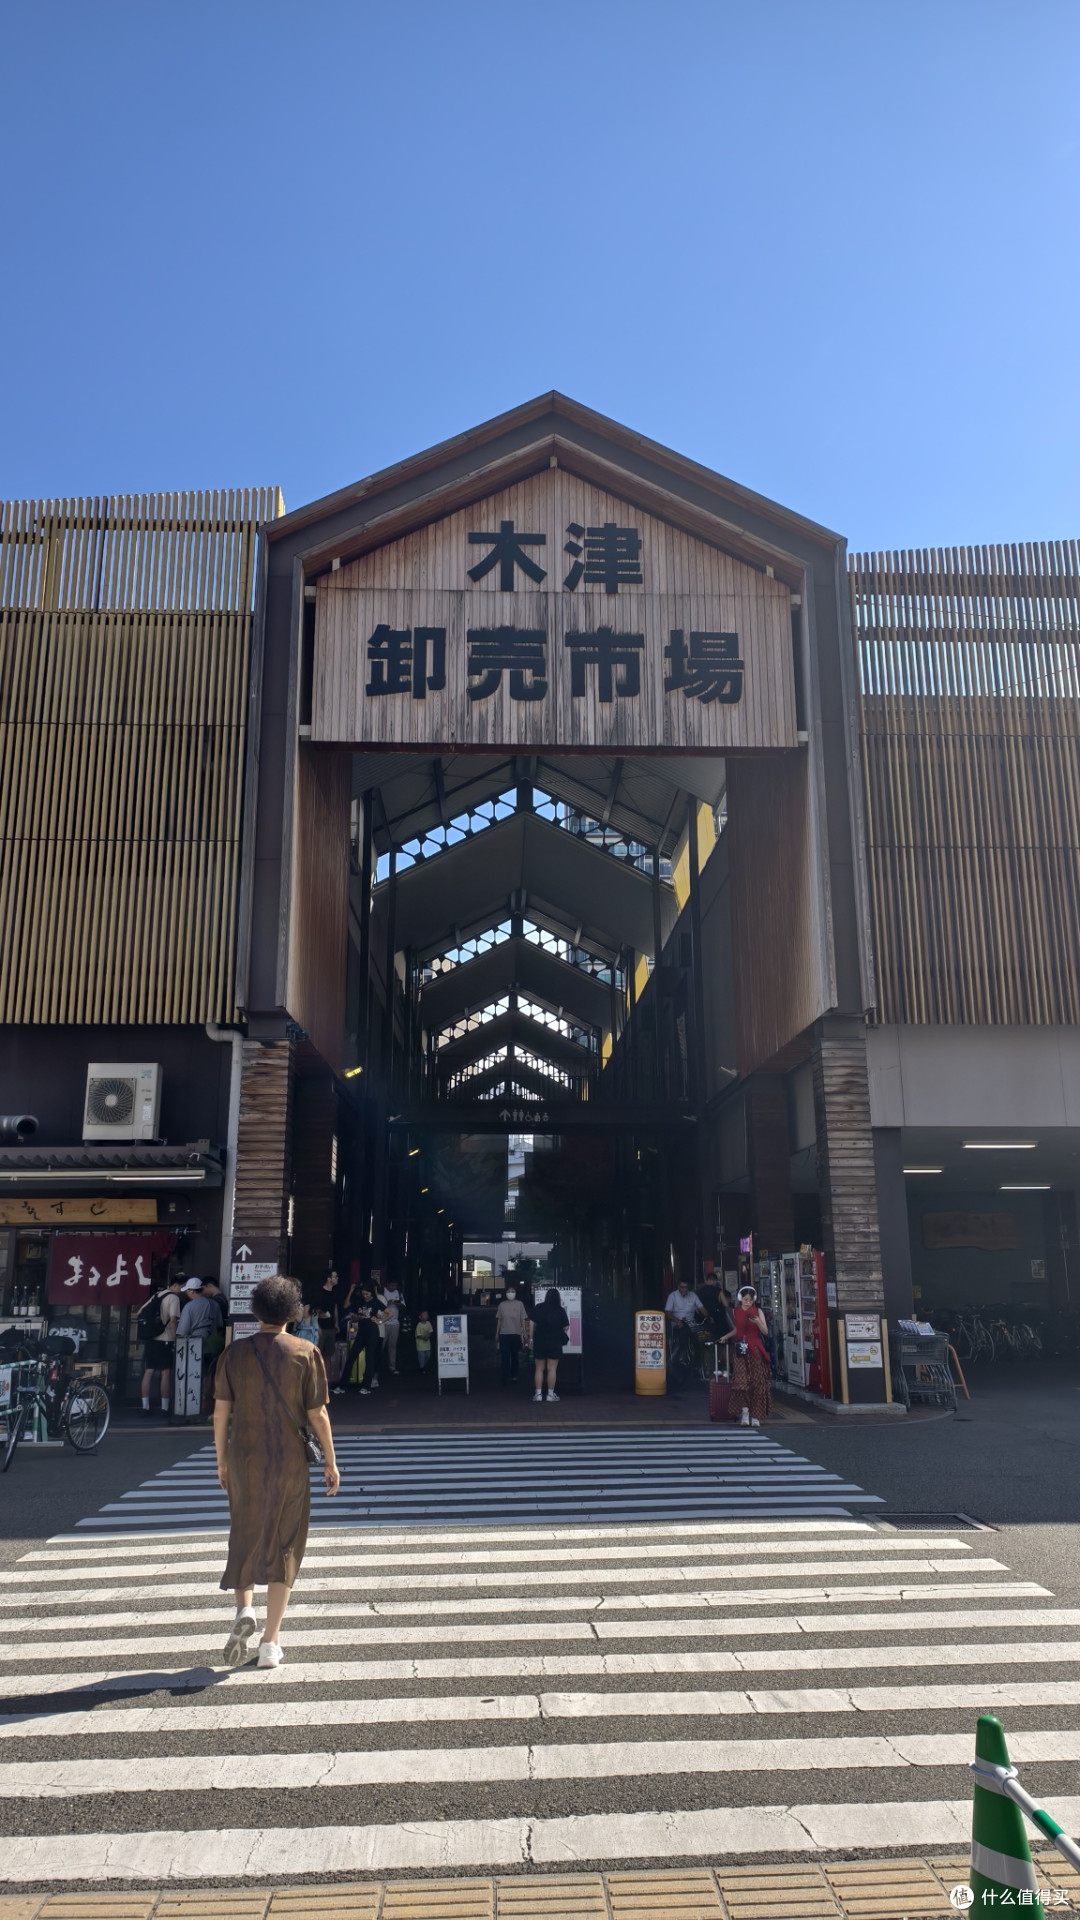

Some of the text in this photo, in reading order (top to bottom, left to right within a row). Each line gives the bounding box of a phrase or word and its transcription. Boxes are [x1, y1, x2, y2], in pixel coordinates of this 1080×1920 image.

[467, 521, 644, 594] 木津
[366, 624, 744, 705] 卸売市場
[50, 1201, 107, 1216] すし
